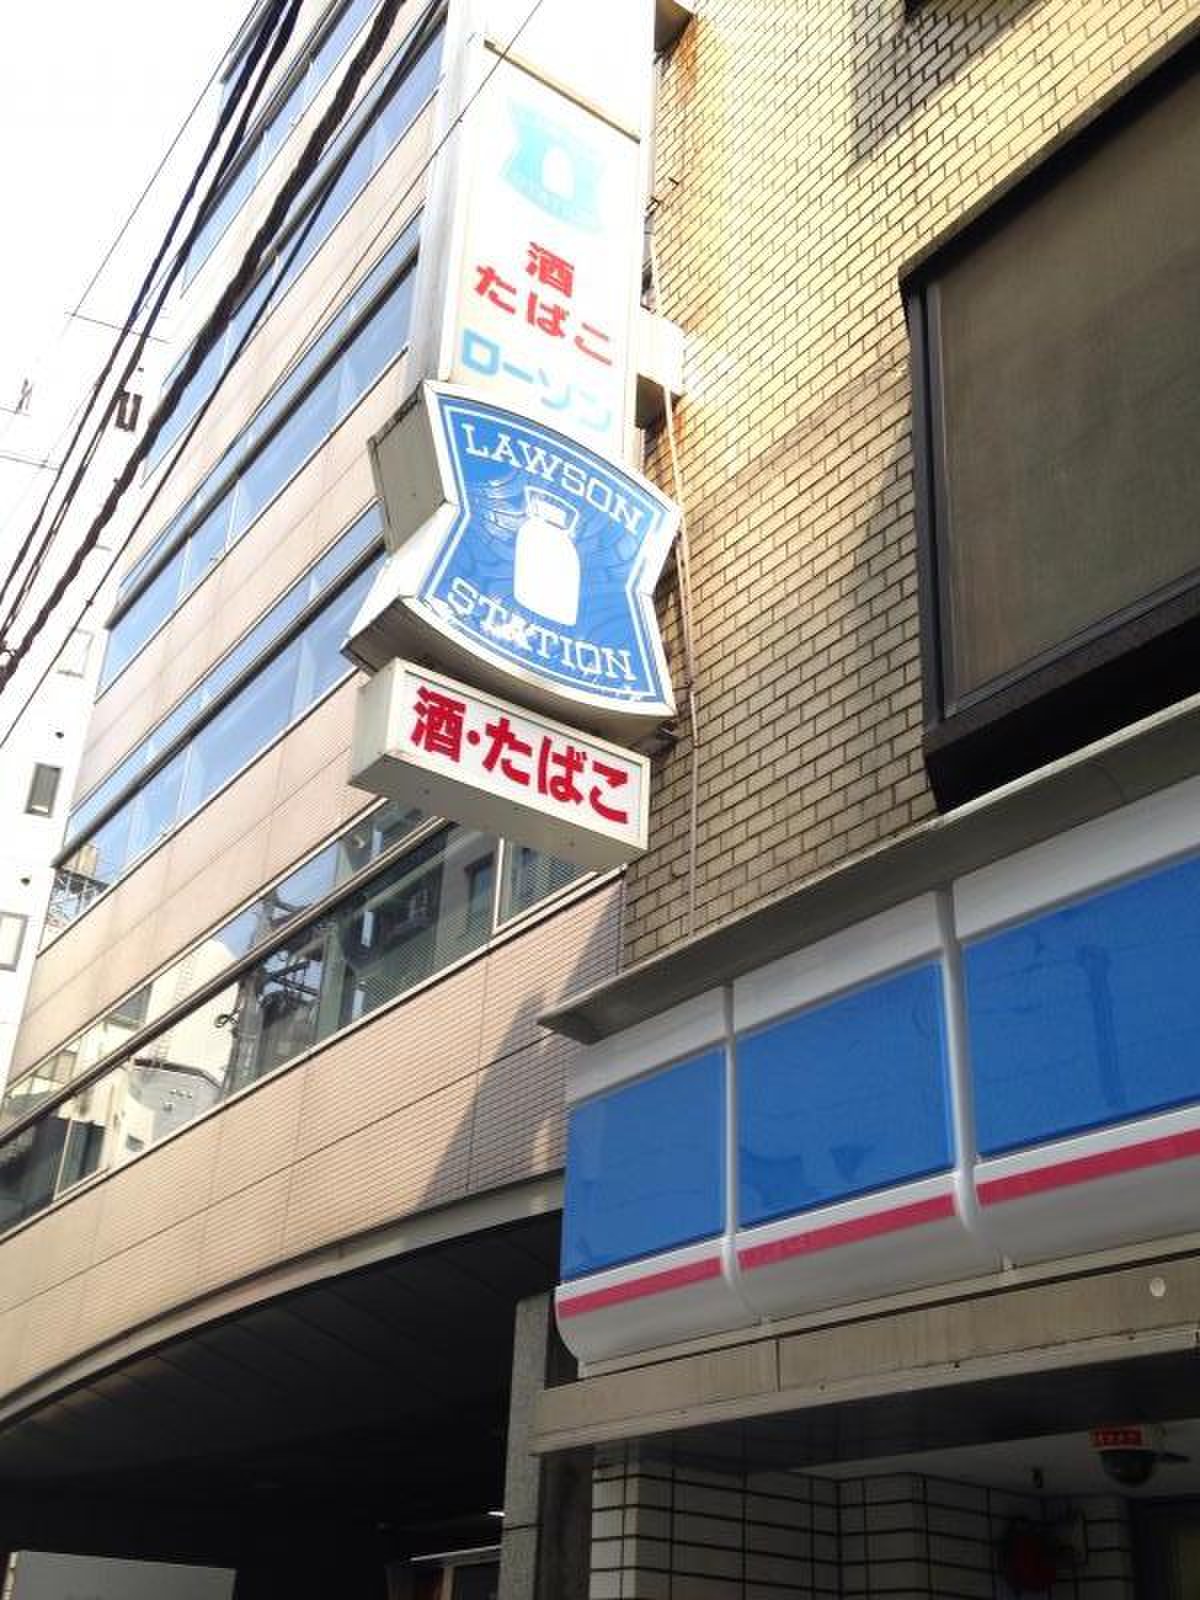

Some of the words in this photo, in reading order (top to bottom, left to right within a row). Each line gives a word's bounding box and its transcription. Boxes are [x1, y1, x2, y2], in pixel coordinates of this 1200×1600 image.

[475, 266, 612, 366] たばこ
[525, 242, 574, 297] 酒
[462, 328, 611, 431] ローソン
[461, 425, 643, 533] LAWSON
[448, 577, 637, 681] STATION
